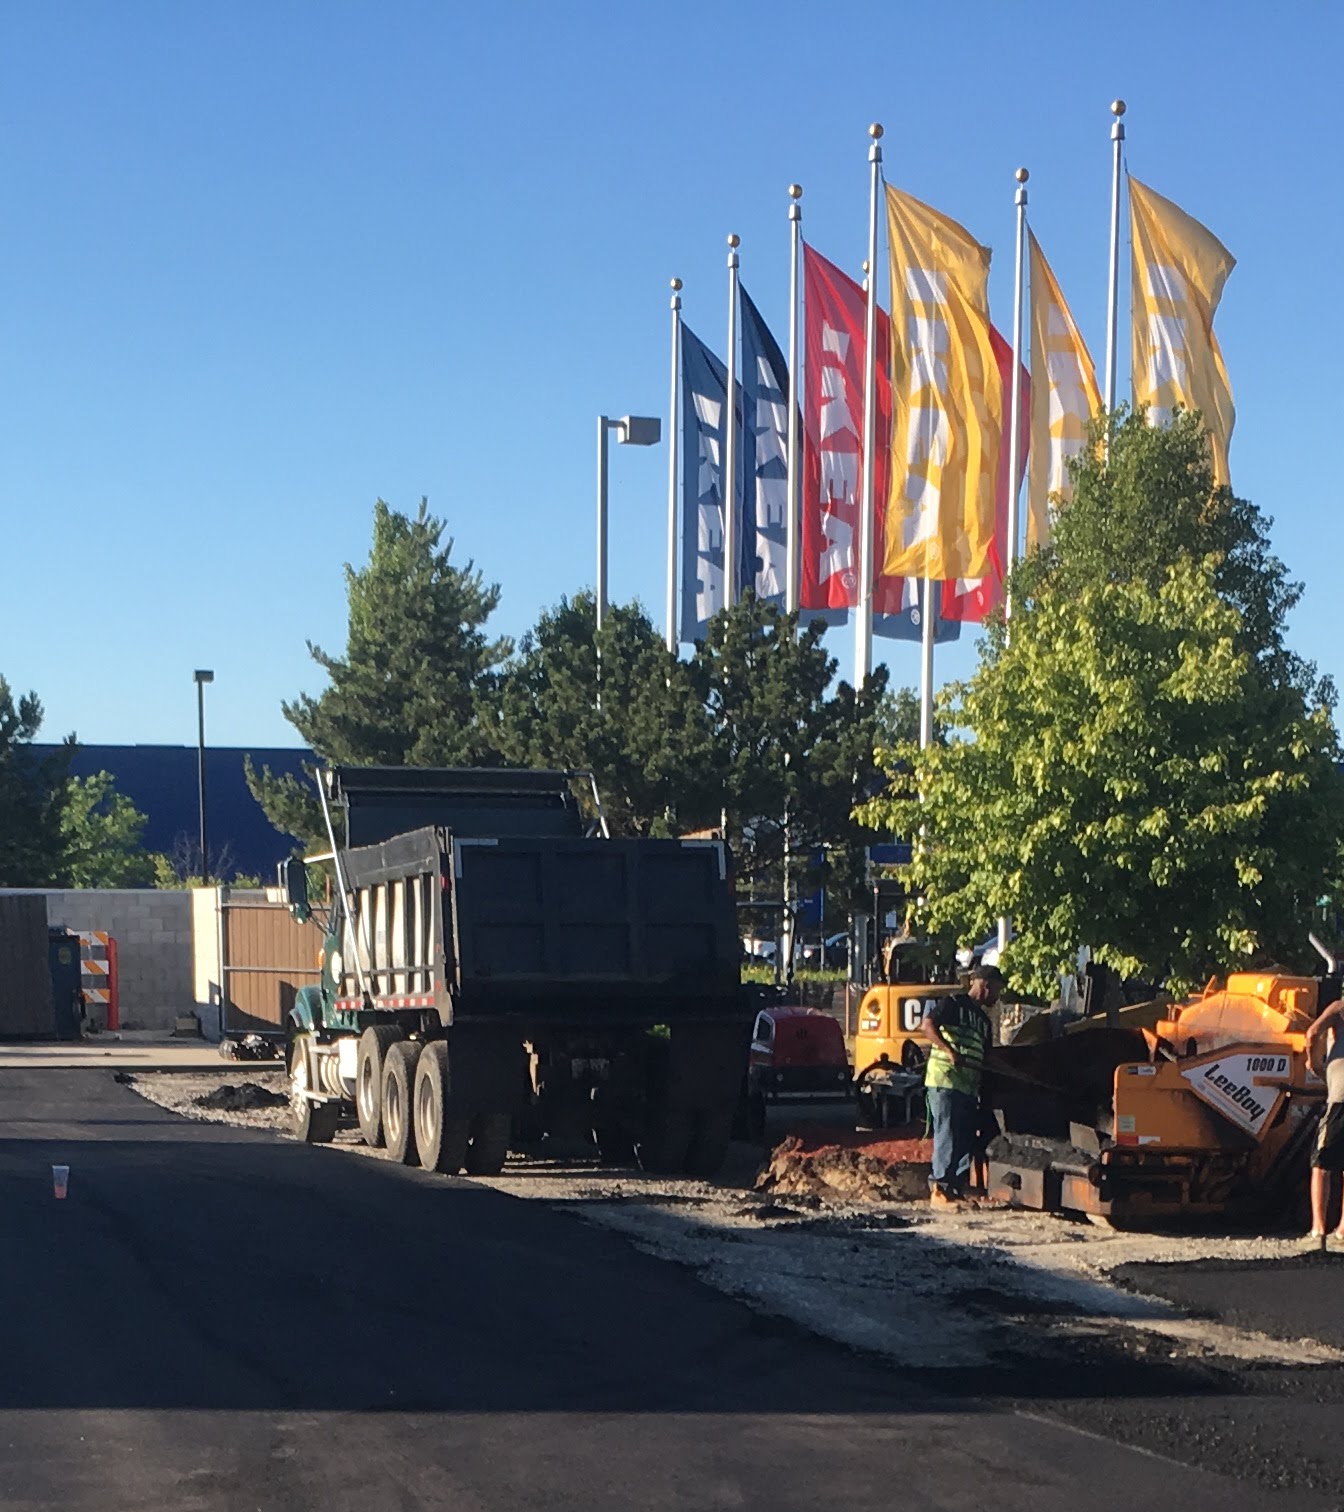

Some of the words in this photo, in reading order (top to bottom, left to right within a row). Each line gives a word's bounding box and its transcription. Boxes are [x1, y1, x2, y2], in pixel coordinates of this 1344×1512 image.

[691, 391, 726, 624] IKEA
[818, 320, 860, 586] IKEA
[903, 266, 954, 549] IKEA
[1204, 1063, 1266, 1122] LeeBoy
[1246, 1057, 1275, 1072] 1000
[1277, 1058, 1287, 1072] D
